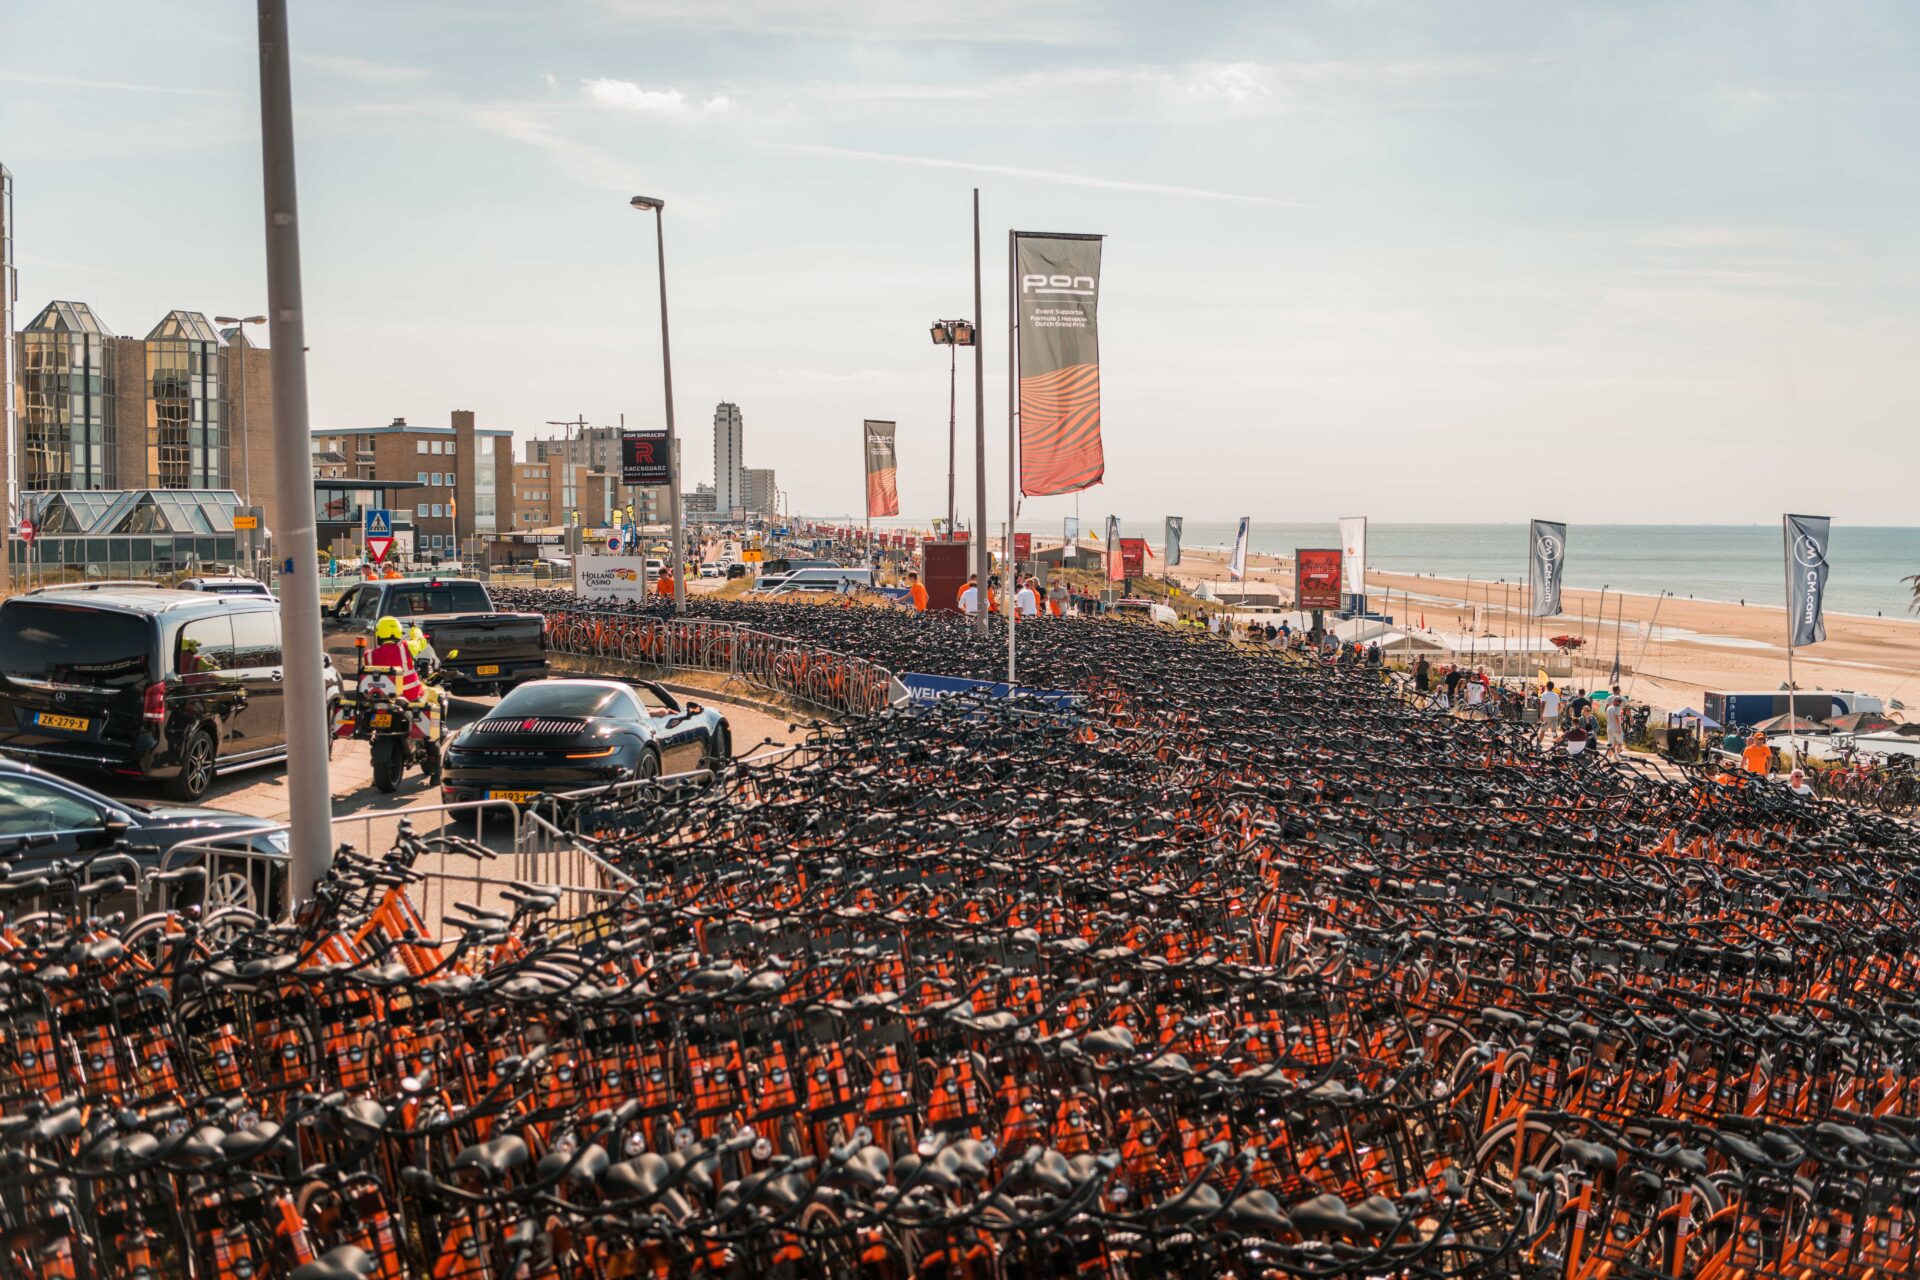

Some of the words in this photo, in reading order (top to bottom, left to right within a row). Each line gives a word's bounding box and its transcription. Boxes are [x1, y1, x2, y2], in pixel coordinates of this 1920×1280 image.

[1545, 563, 1553, 602] CM.com
[1805, 571, 1817, 624] CM.com
[41, 715, 85, 729] ZK-279-X
[1840, 737, 1855, 748] 25
